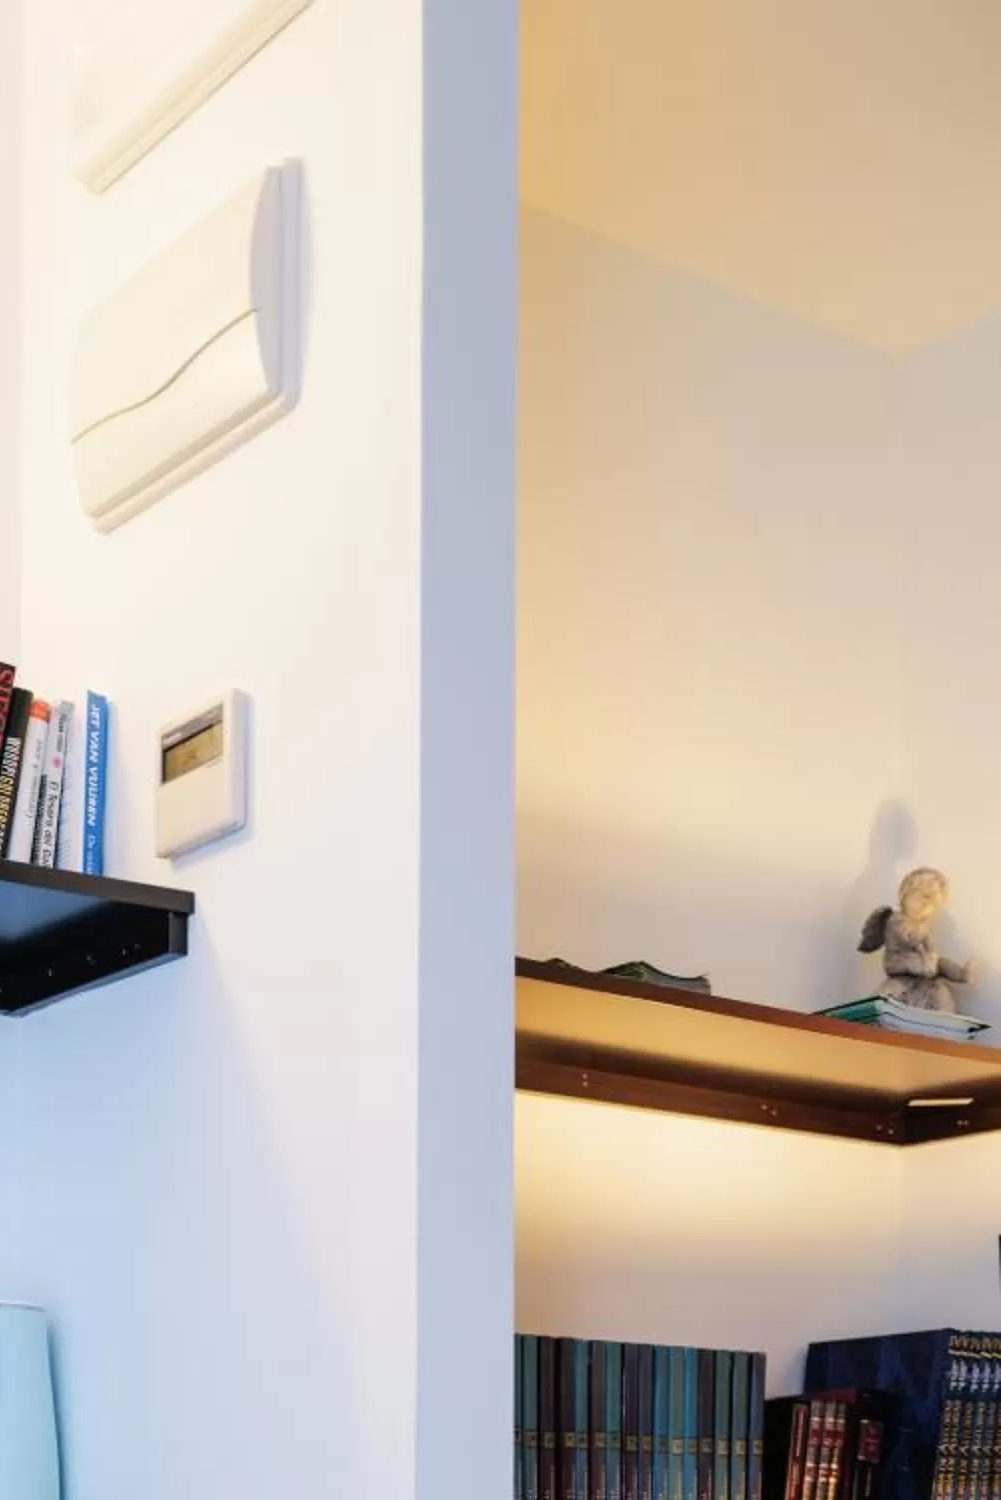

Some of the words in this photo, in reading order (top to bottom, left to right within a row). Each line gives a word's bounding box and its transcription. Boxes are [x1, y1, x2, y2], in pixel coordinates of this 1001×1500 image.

[91, 704, 100, 729] JET
[89, 730, 100, 762] VAN
[88, 766, 99, 827] VUUREN
